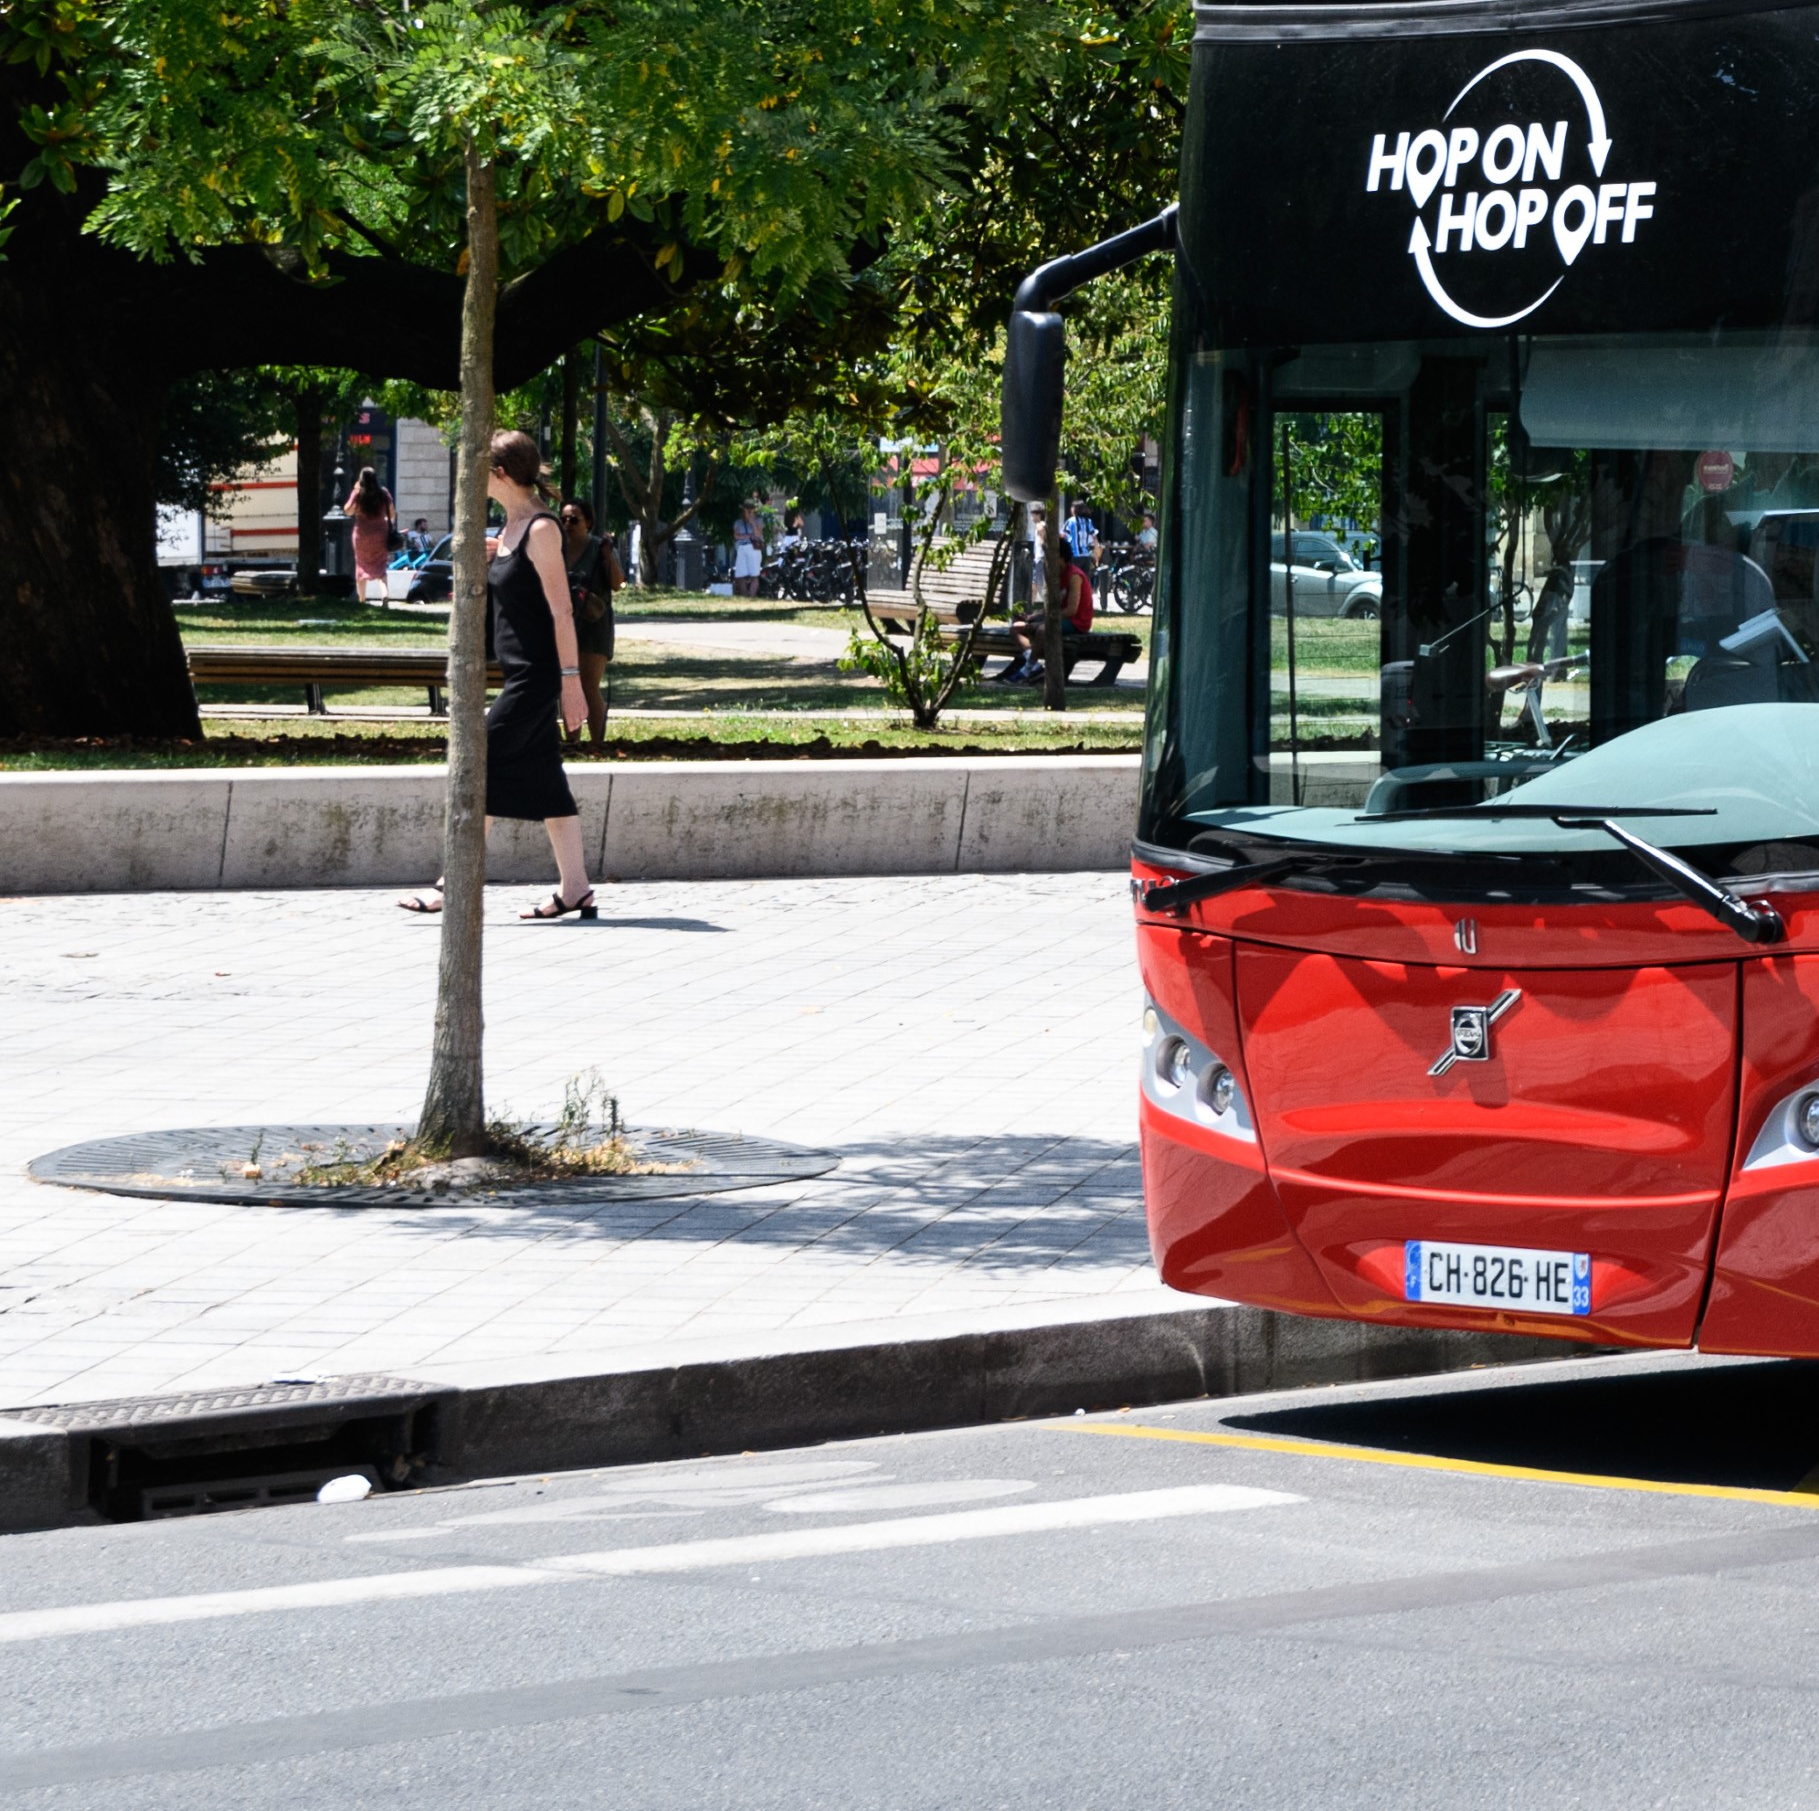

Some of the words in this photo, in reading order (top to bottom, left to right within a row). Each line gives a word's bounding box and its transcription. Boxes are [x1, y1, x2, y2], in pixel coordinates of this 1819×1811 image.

[1366, 127, 1480, 208] HOP
[1482, 121, 1568, 182] ON
[1436, 189, 1548, 253] HOP
[1552, 182, 1656, 265] OFF
[1573, 1286, 1590, 1308] 33
